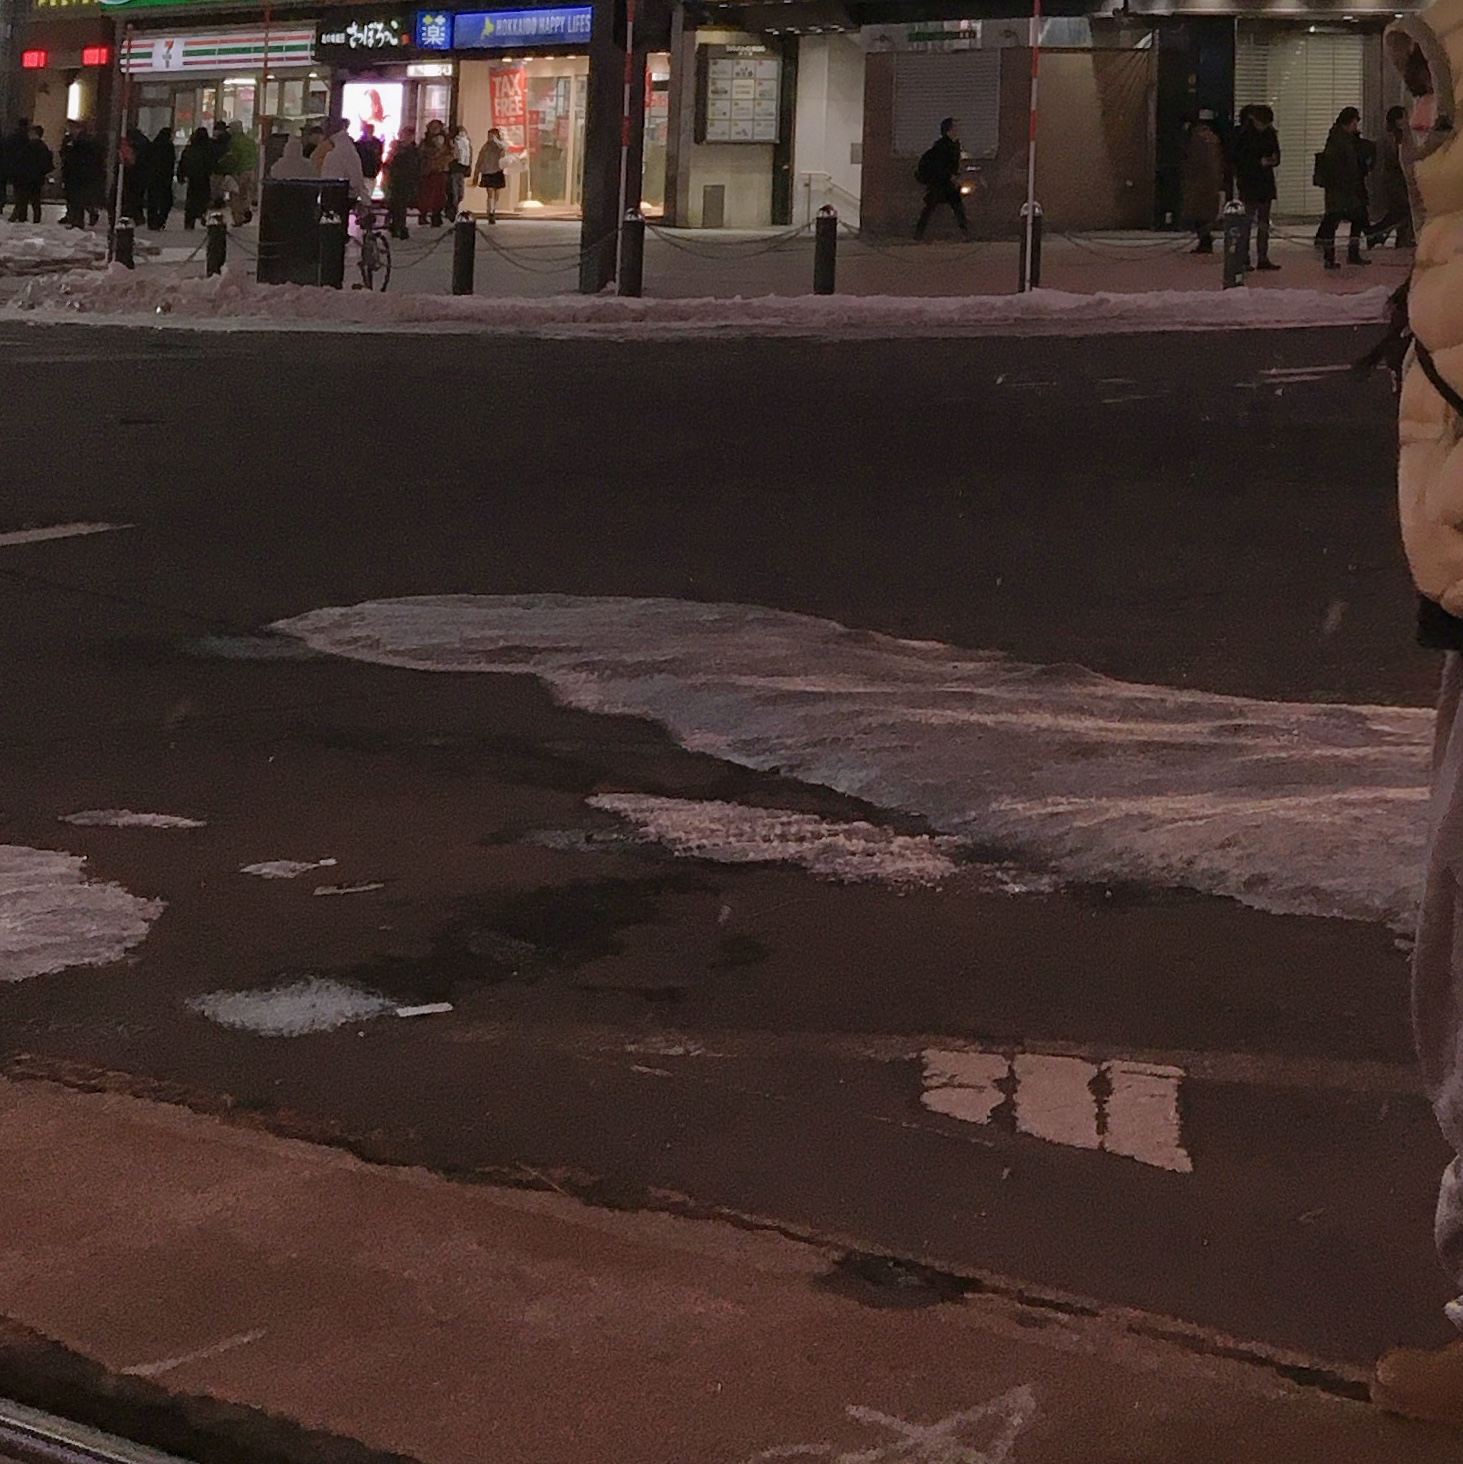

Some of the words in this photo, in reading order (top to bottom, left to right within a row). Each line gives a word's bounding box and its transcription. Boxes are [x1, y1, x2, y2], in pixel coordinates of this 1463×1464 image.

[496, 18, 537, 36] HOKKAIDO
[537, 16, 566, 34] HAPPY
[492, 73, 523, 97] TAX
[493, 95, 524, 118] FREE
